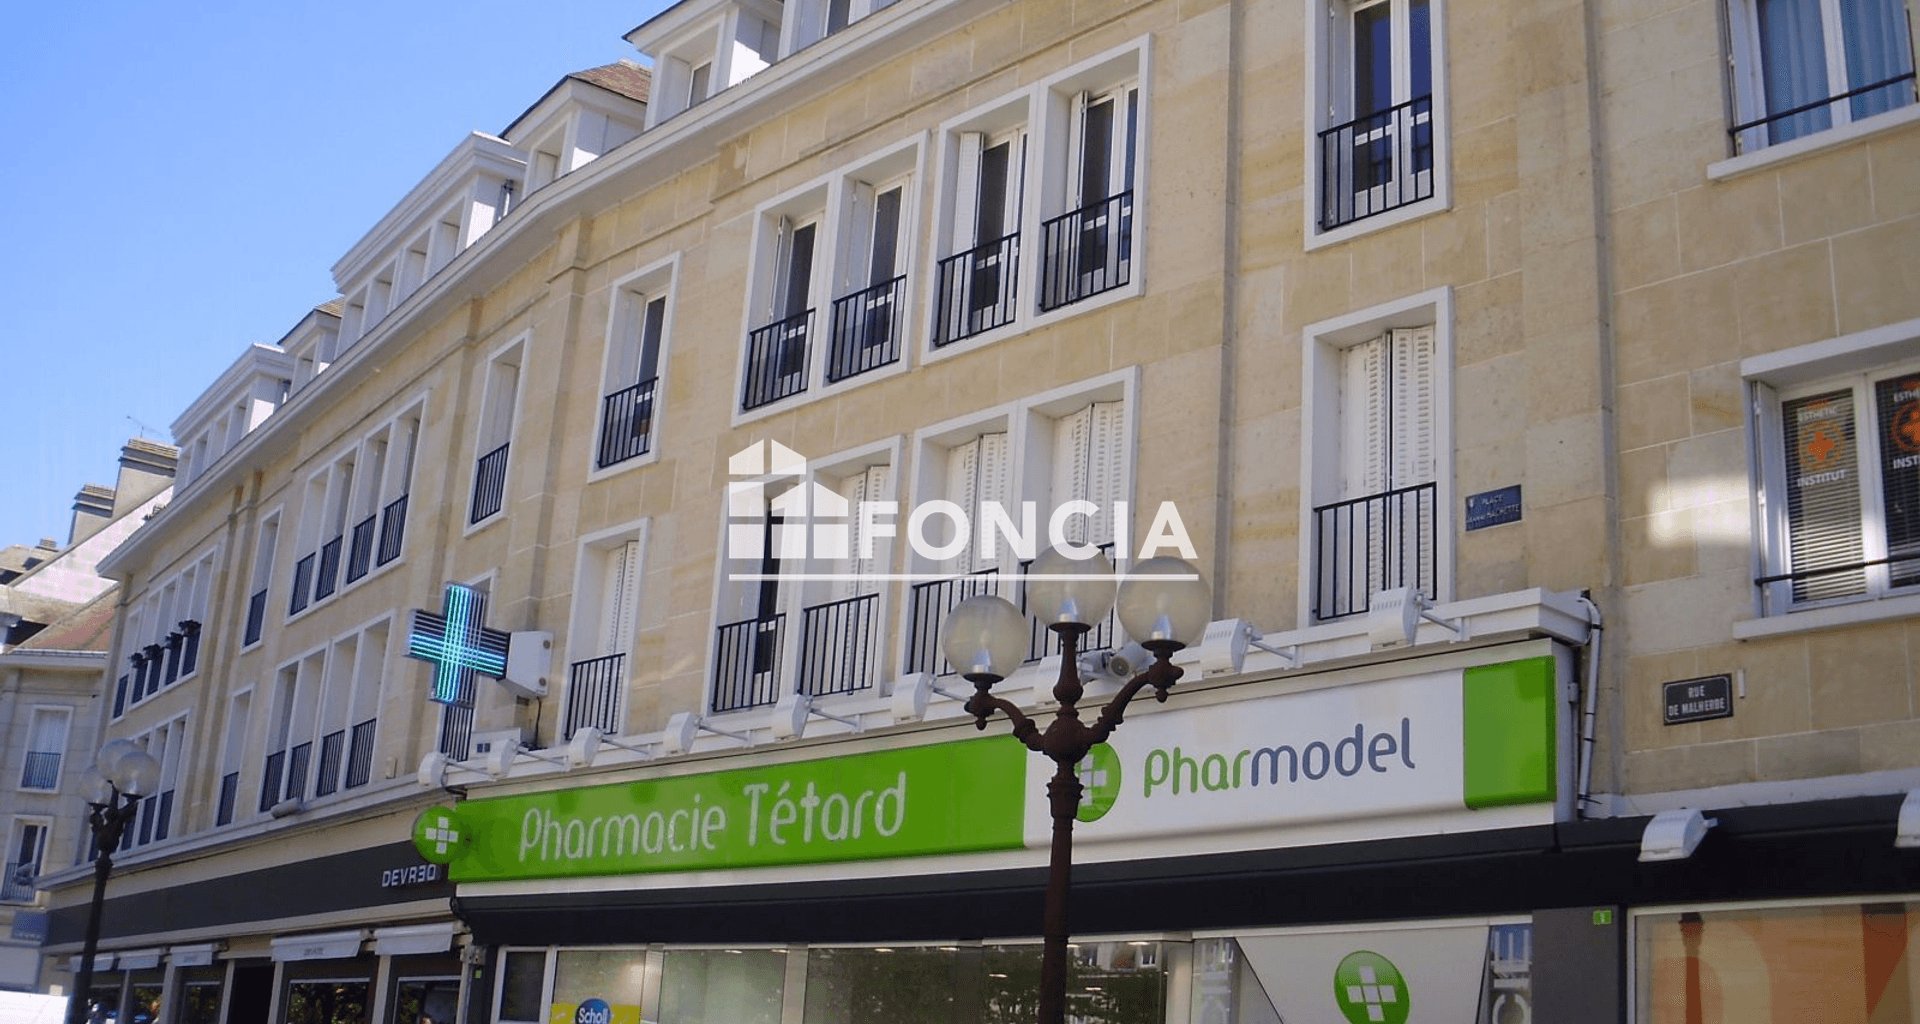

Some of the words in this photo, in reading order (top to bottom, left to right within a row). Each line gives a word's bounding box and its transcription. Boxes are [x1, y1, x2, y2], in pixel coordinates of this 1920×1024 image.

[1797, 468, 1847, 488] INSTITUT
[1481, 493, 1504, 505] PLACE
[1688, 685, 1705, 698] RUE
[1668, 704, 1679, 716] DE
[1682, 697, 1725, 714] MALHERBE
[518, 793, 726, 863] Pharmacie
[743, 771, 906, 847] Tétard
[578, 1008, 609, 1024] Scholl
